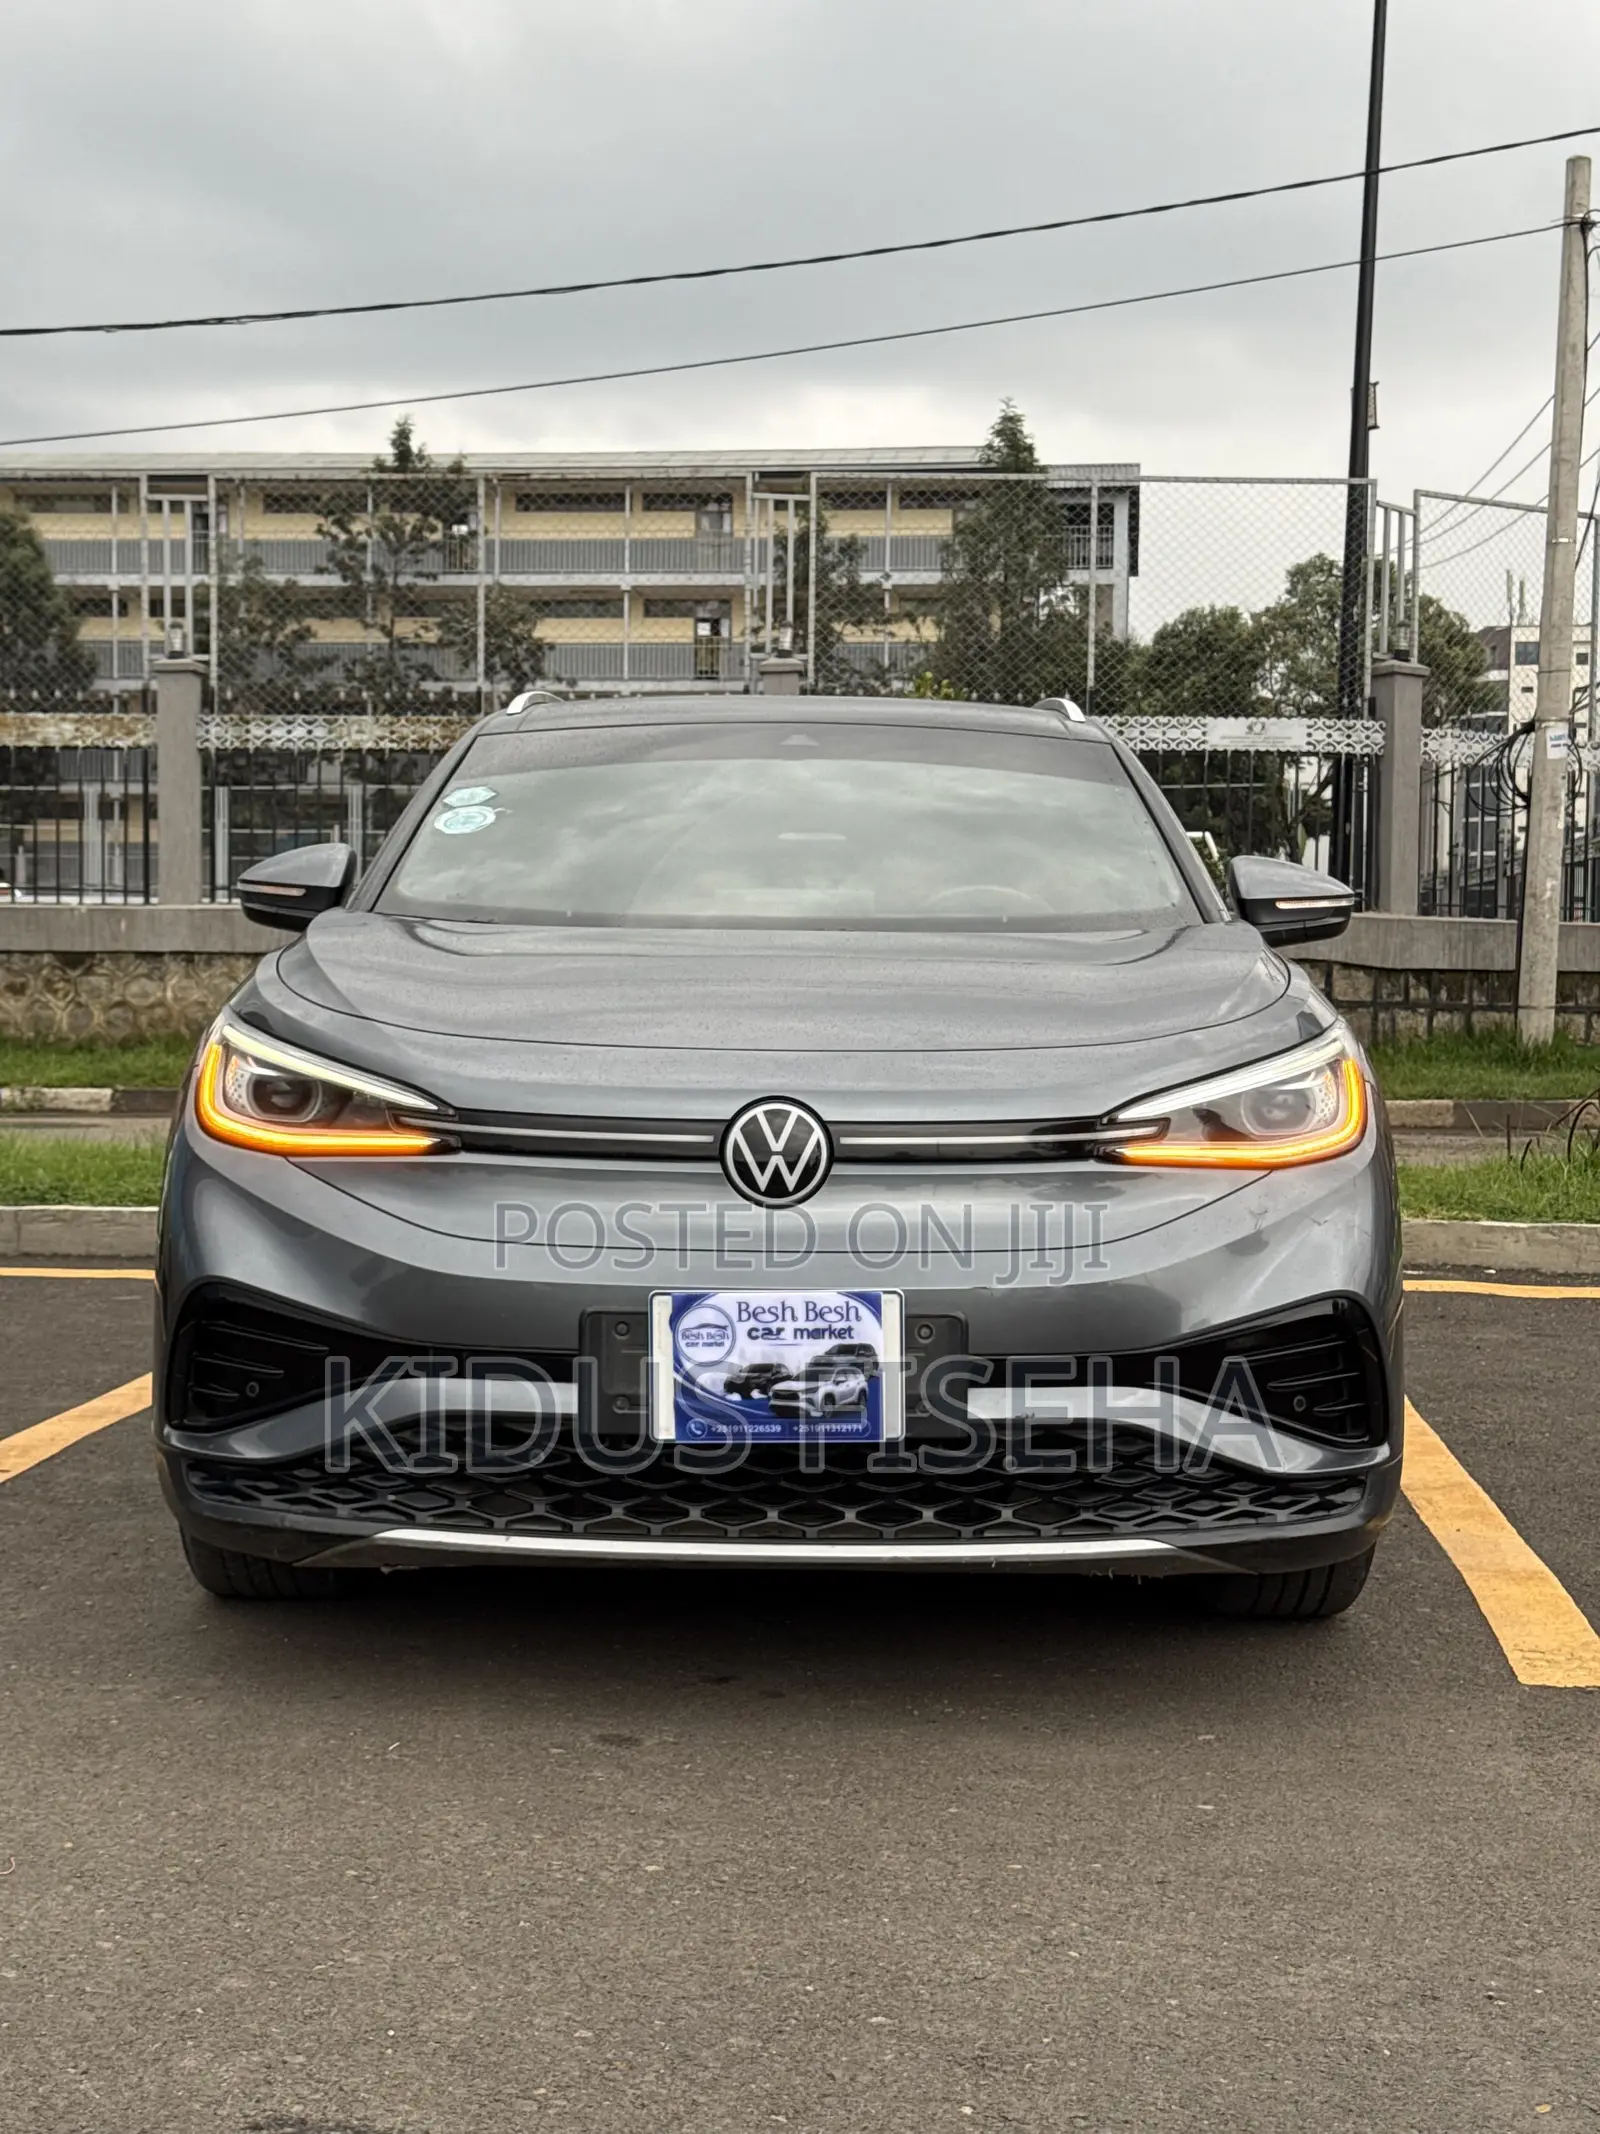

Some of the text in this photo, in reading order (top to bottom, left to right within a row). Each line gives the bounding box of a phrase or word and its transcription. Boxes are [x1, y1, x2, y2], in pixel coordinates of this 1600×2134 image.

[736, 1300, 863, 1323] Besh Besh
[746, 1325, 855, 1341] car market
